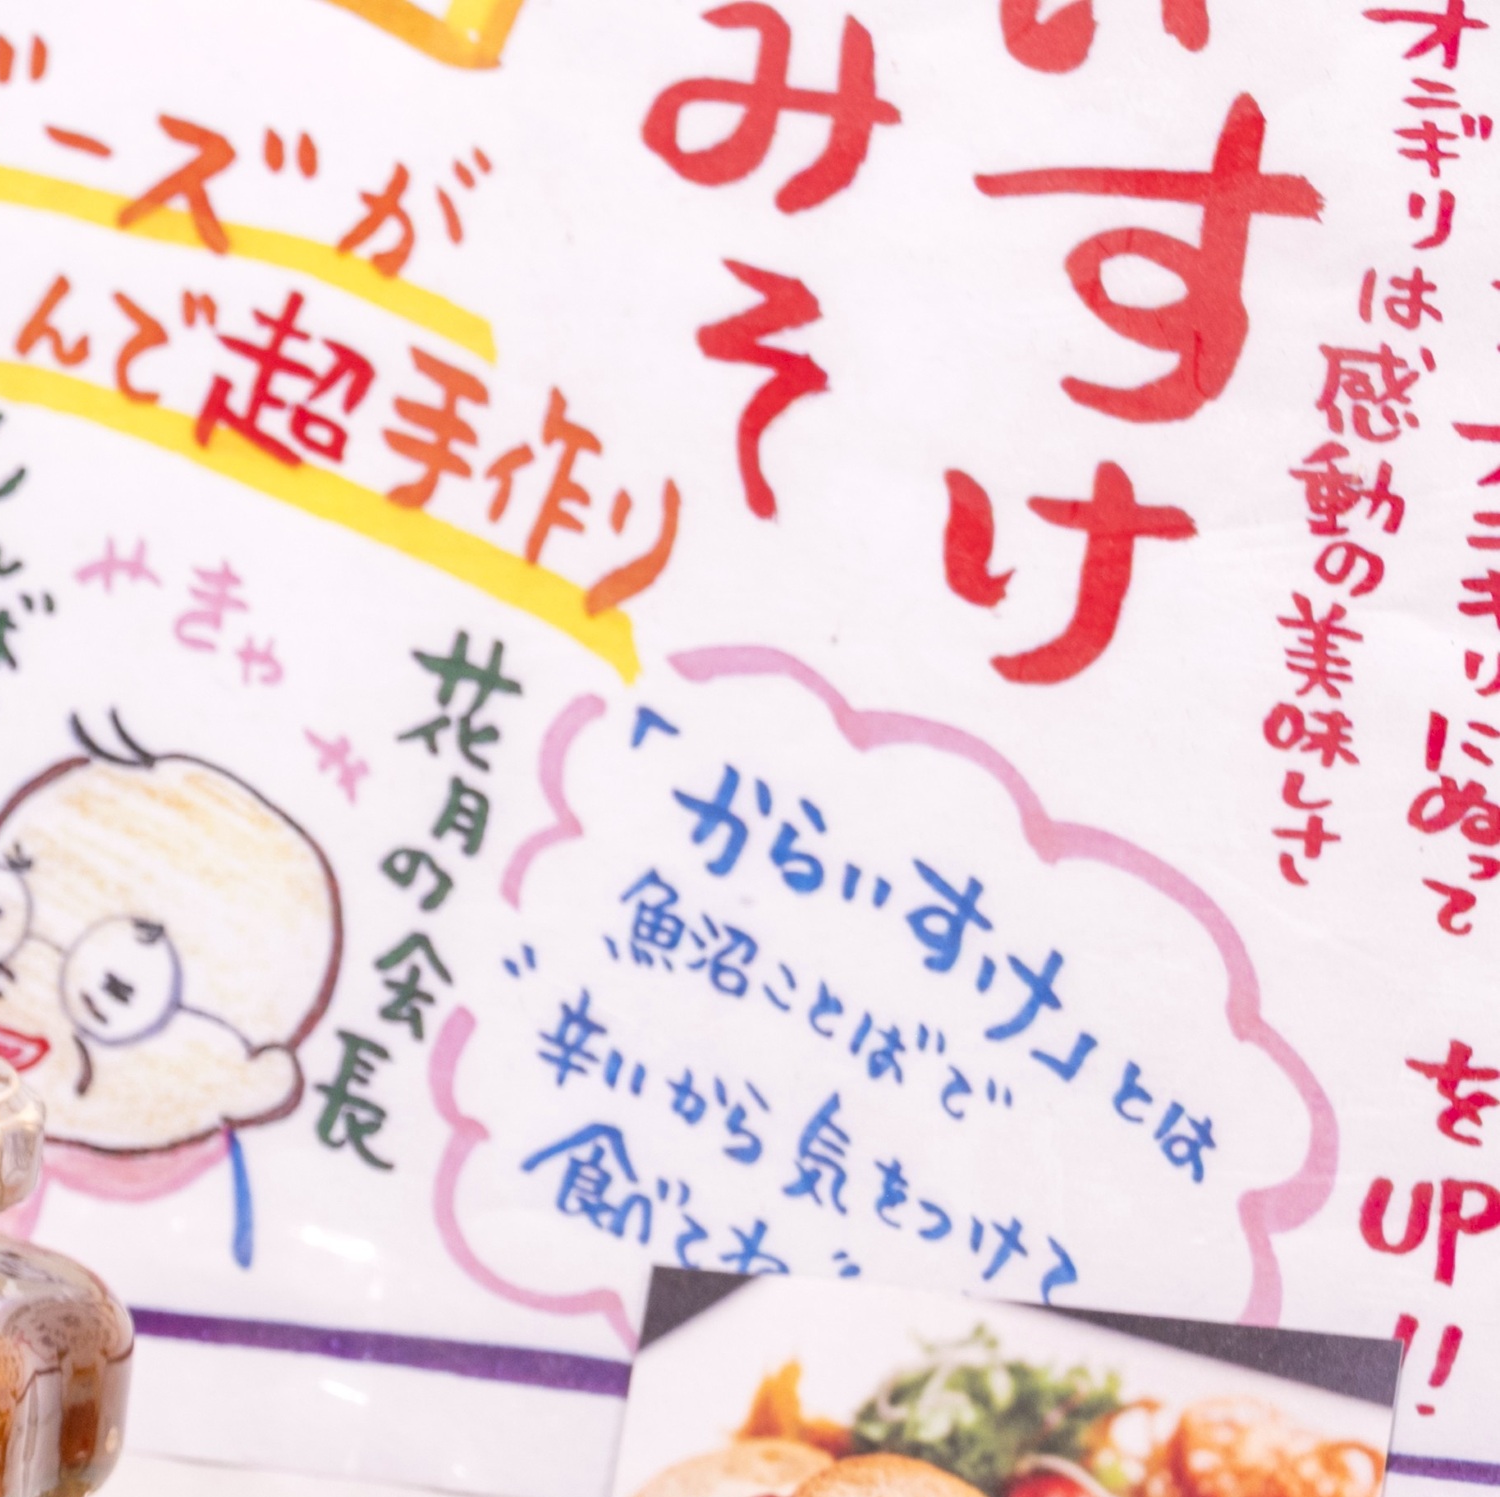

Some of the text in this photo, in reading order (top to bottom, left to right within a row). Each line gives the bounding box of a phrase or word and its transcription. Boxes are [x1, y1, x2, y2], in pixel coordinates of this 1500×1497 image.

[641, 0, 903, 521] みそ
[312, 630, 523, 1173] 花月の会長
